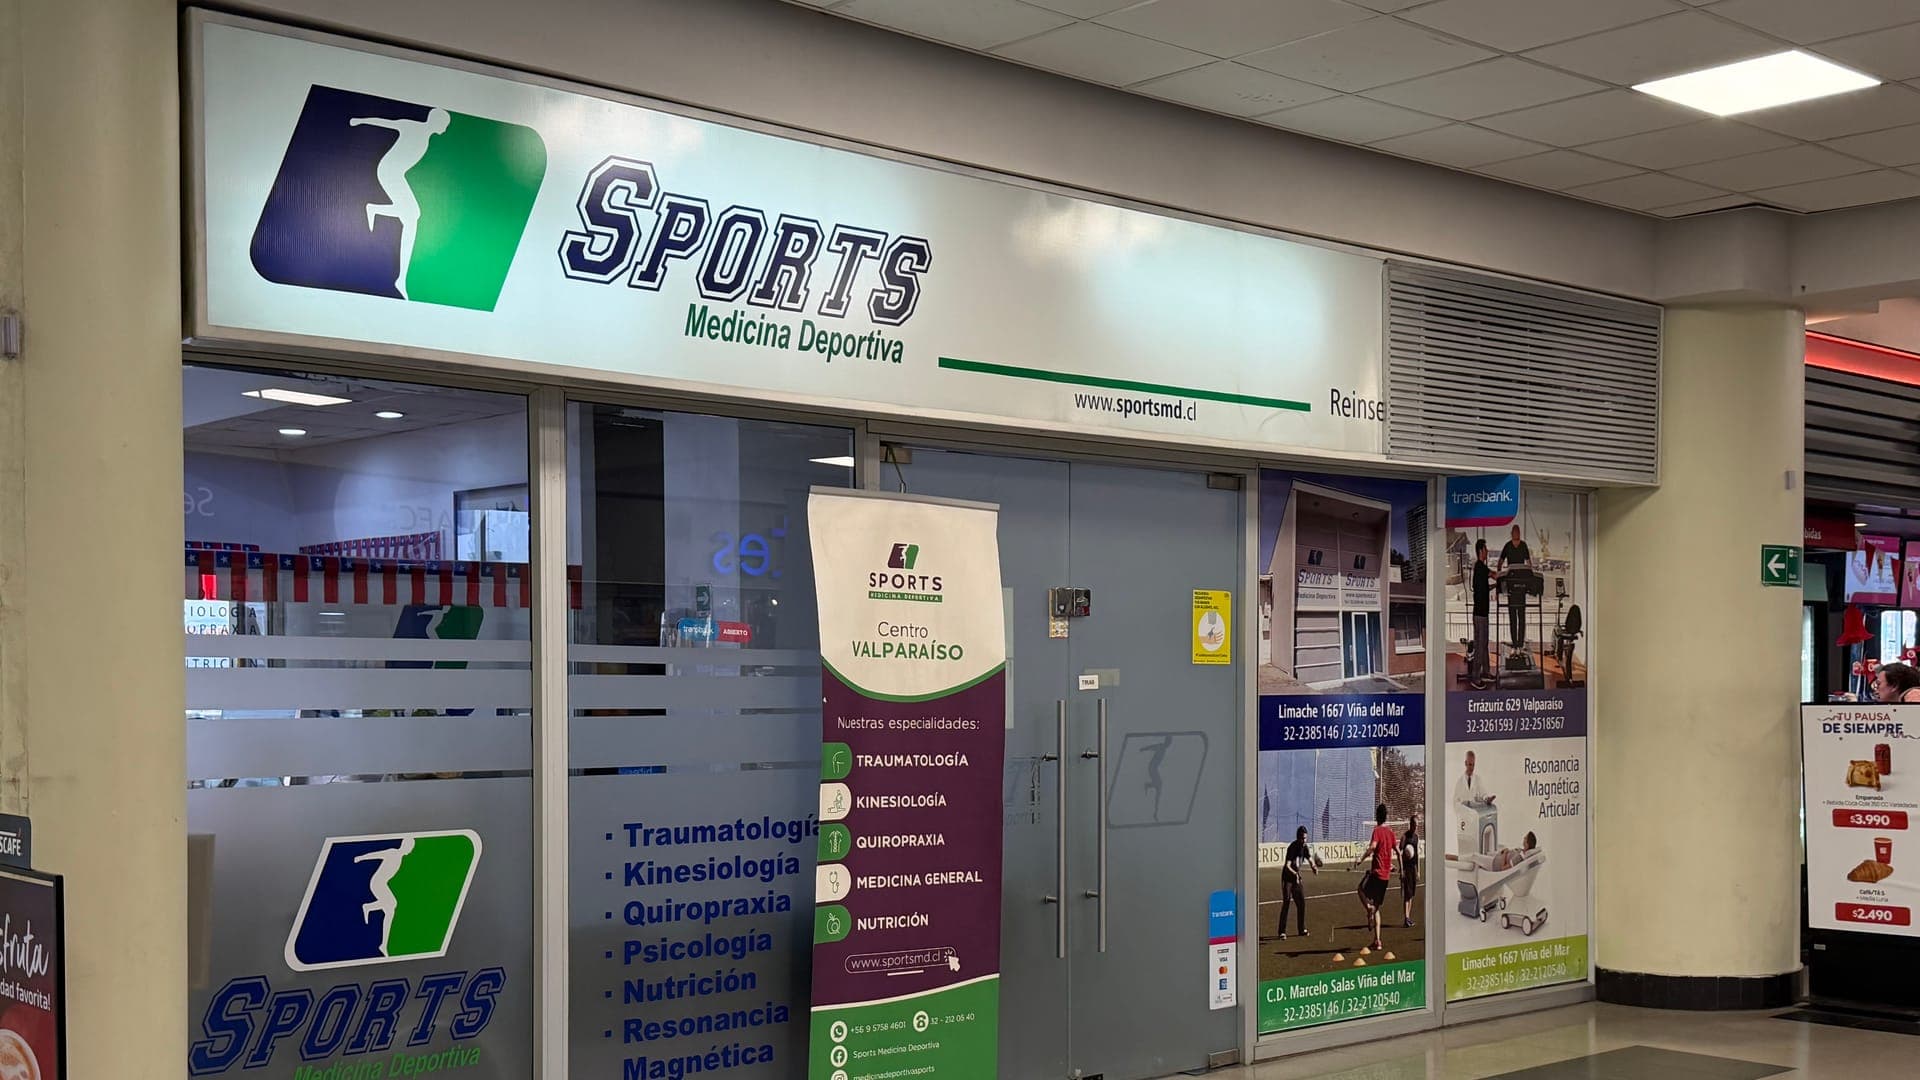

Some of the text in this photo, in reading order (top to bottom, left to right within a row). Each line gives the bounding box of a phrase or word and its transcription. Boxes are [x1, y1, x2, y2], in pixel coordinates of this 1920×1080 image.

[558, 155, 932, 326] SPORTS
[685, 303, 904, 363] Medicina Deportiva
[1075, 391, 1197, 422] www.sportsmd.cl
[1331, 388, 1384, 422] Reinse
[1452, 489, 1513, 504] transbank.
[869, 572, 942, 591] SPORTS
[1298, 568, 1333, 585] SPORTS
[1345, 573, 1376, 588] SPORTS
[878, 622, 928, 639] Centro
[852, 640, 964, 660] VALPARAÍSO
[1279, 702, 1405, 719] Limache 1667 Viña del Mar
[1505, 698, 1521, 712] 629
[1522, 696, 1564, 713] Valparaíso
[837, 716, 980, 732] Nuestras especialidades:
[1466, 718, 1514, 733] 32-3261593
[1520, 717, 1566, 731] 32-2518567
[1838, 712, 1890, 721] TU PAUSA
[1284, 725, 1339, 740] 32-2385146
[1347, 723, 1400, 739] 32-2120540
[1823, 723, 1841, 733] DE
[856, 752, 969, 767] TRAUMATOLOGÍA
[1524, 755, 1580, 774] Resonancia
[1528, 777, 1580, 800] Magnética
[856, 792, 947, 809] KINESIOLOGÍA
[1538, 799, 1581, 819] Articular
[1850, 814, 1890, 826] $3.990
[856, 833, 946, 849] QUIROPRAXIA
[624, 852, 800, 887] Kinesiología
[856, 871, 983, 889] MEDICINA GENERAL
[624, 890, 791, 927] Quiropraxia
[1852, 908, 1893, 921] $2.490
[857, 912, 929, 931] NUTRICIÓN
[624, 929, 772, 965] Psicología
[851, 951, 941, 969] www.sportsmd.cl
[1462, 944, 1570, 971] Limache 1667 Viña del Mar
[624, 968, 756, 1004] Nutrición
[1266, 969, 1415, 1003] C.D. Marcelo Salas Viña del Mar
[1466, 972, 1515, 991] 32-2385146
[16, 983, 51, 1010] favorita!
[1284, 999, 1340, 1022] 32-2385146
[1347, 991, 1400, 1011] 32-2120540
[188, 966, 507, 1078] SPORTS
[624, 1002, 789, 1044] Resonancia
[850, 1025, 864, 1034] +56
[866, 1024, 871, 1033] 9
[872, 1023, 889, 1032] 5758
[853, 1041, 940, 1060] Sports Medicina Deportiva
[388, 1044, 481, 1079] Deportiva
[624, 1042, 774, 1080] Magnética
